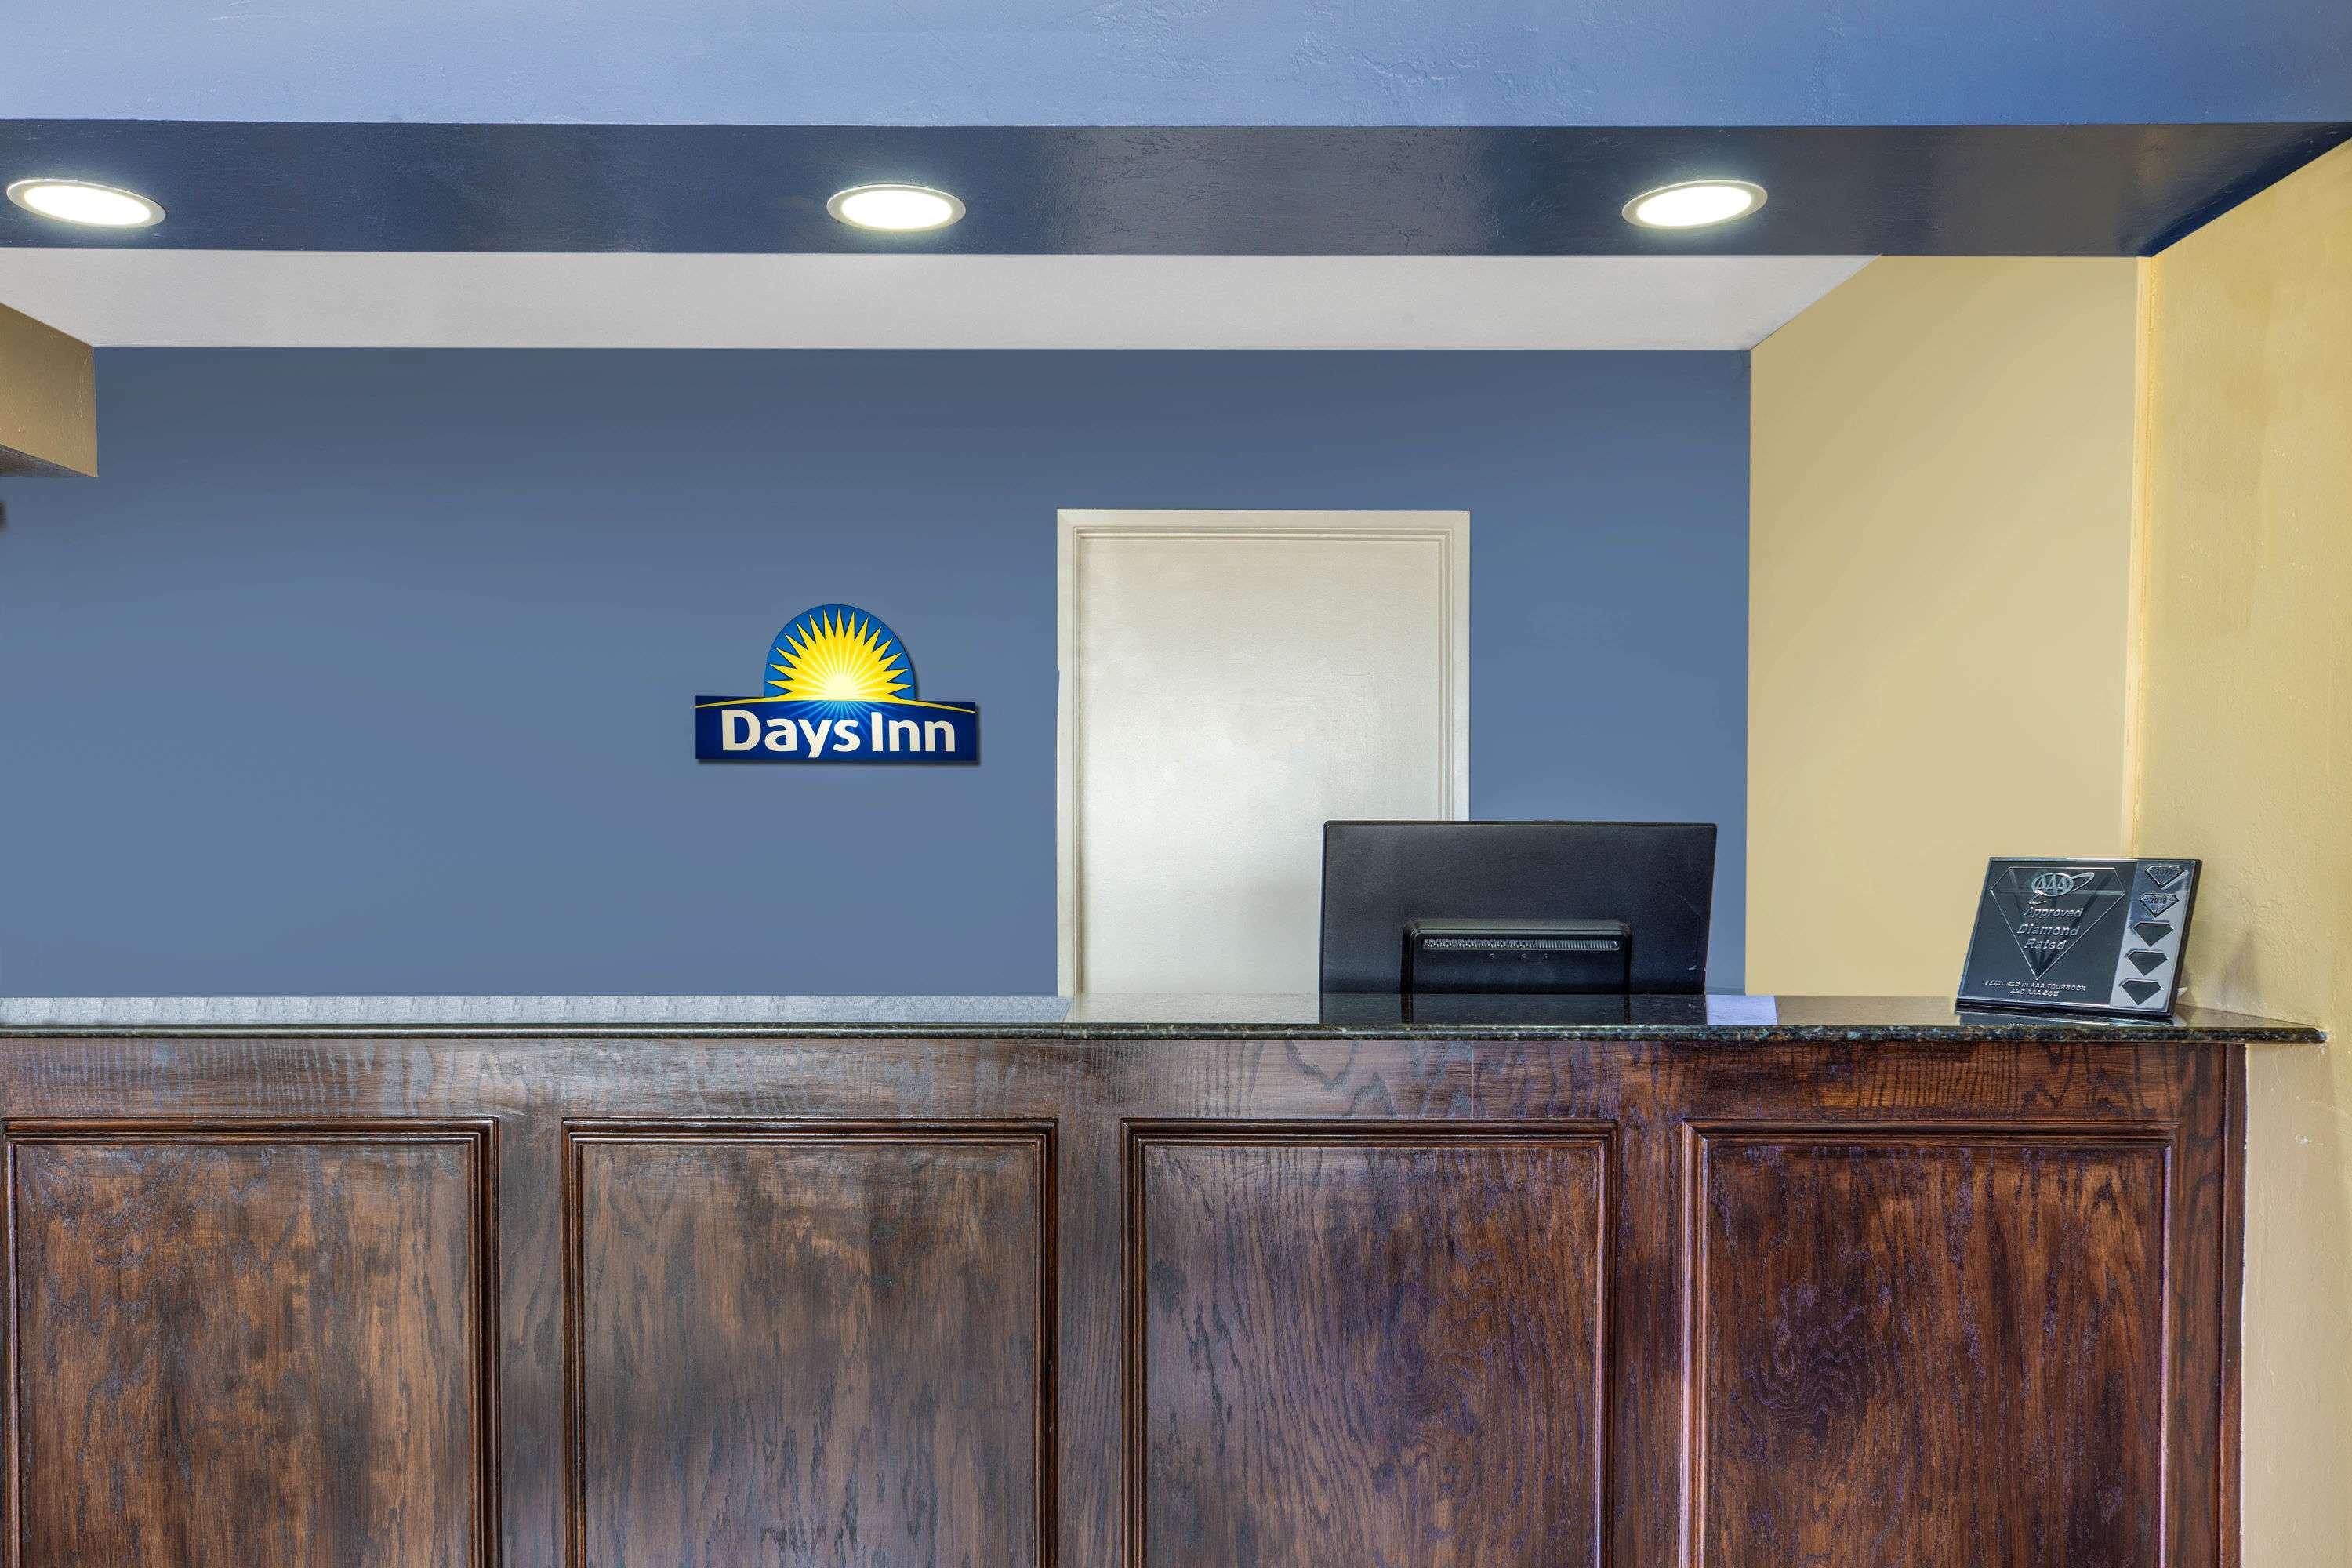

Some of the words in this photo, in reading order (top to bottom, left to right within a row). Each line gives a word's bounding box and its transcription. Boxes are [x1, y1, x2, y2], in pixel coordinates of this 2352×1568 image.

[720, 709, 861, 758] Days
[870, 711, 956, 752] Inn
[2034, 872, 2070, 895] AAA
[2023, 906, 2085, 919] Approved
[2016, 924, 2080, 936] Diamond
[2024, 938, 2067, 950] Rated
[2047, 983, 2086, 992] TOURBOOK
